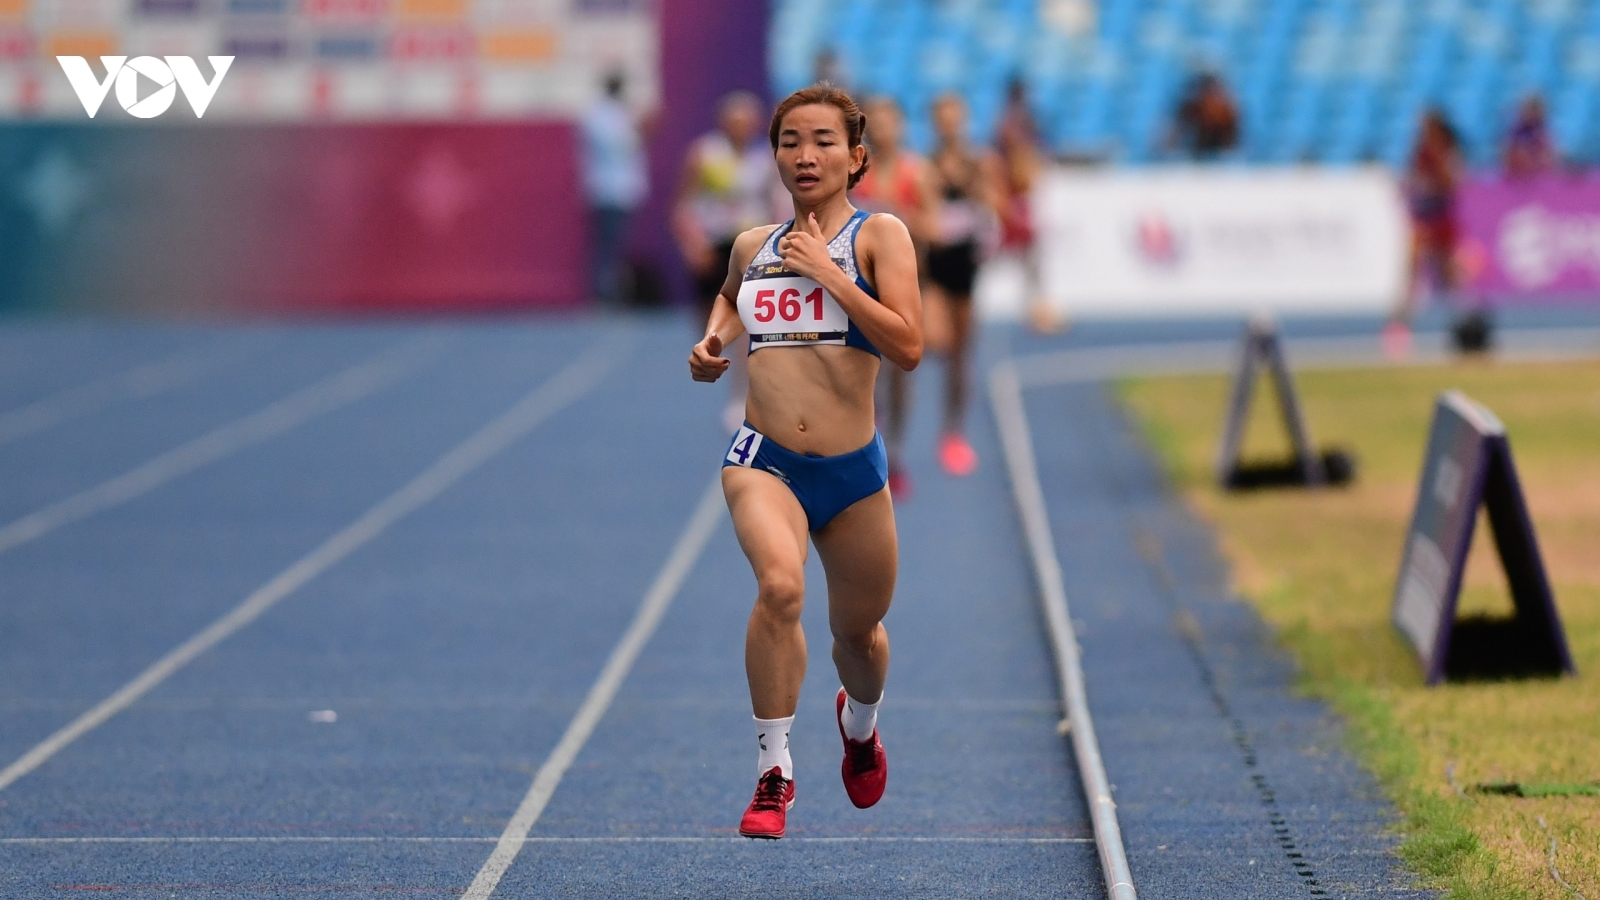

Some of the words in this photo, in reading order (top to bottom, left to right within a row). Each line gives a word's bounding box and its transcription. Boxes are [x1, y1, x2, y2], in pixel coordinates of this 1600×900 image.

[765, 266, 783, 274] 32nd
[754, 287, 823, 322] 561
[733, 433, 756, 464] 4
